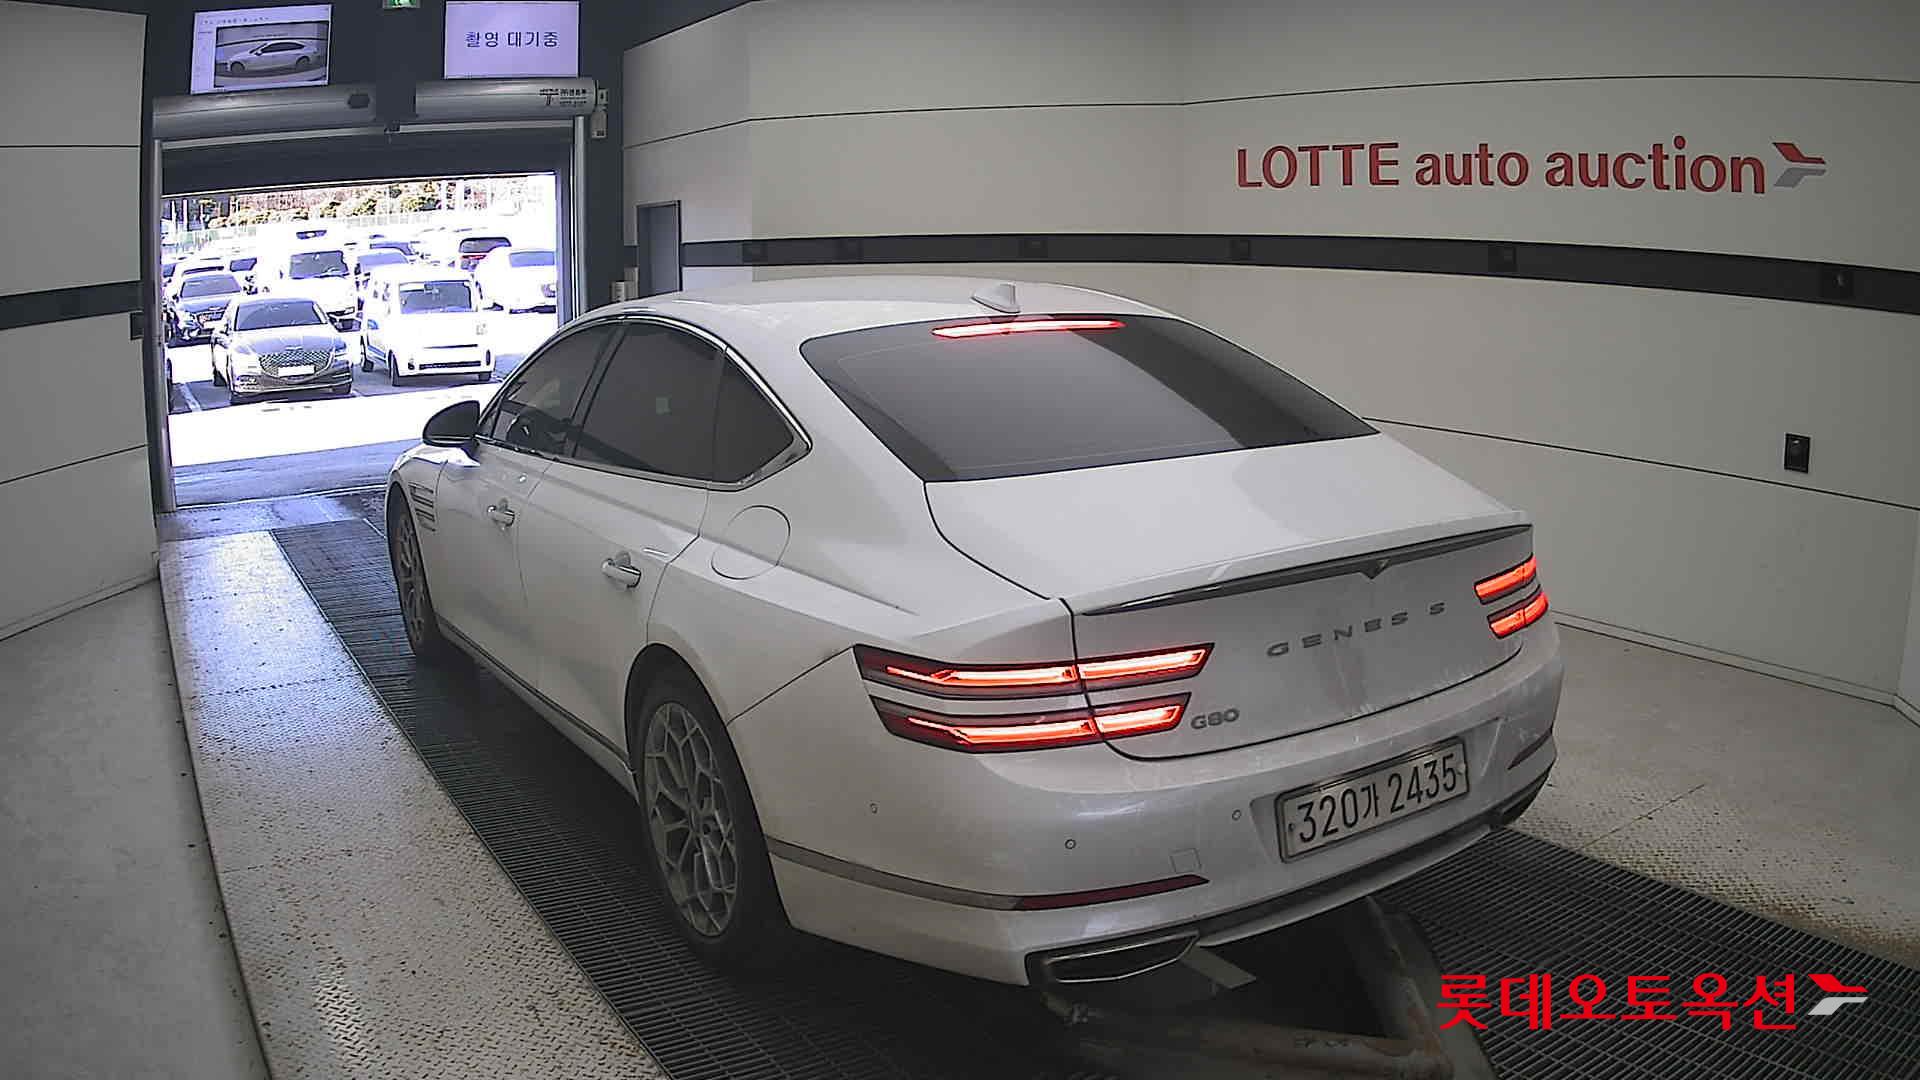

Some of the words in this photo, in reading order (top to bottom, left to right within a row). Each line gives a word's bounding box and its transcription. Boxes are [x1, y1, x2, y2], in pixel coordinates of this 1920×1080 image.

[466, 31, 499, 48] 촬영
[507, 31, 558, 48] 대기중
[1237, 142, 1400, 188] LOTTE
[1415, 143, 1529, 187] auto
[1545, 135, 1765, 194] auction
[1267, 602, 1445, 657] GENESS
[1191, 708, 1240, 729] G80
[1297, 783, 1379, 842] 320가
[1387, 753, 1457, 815] 2435
